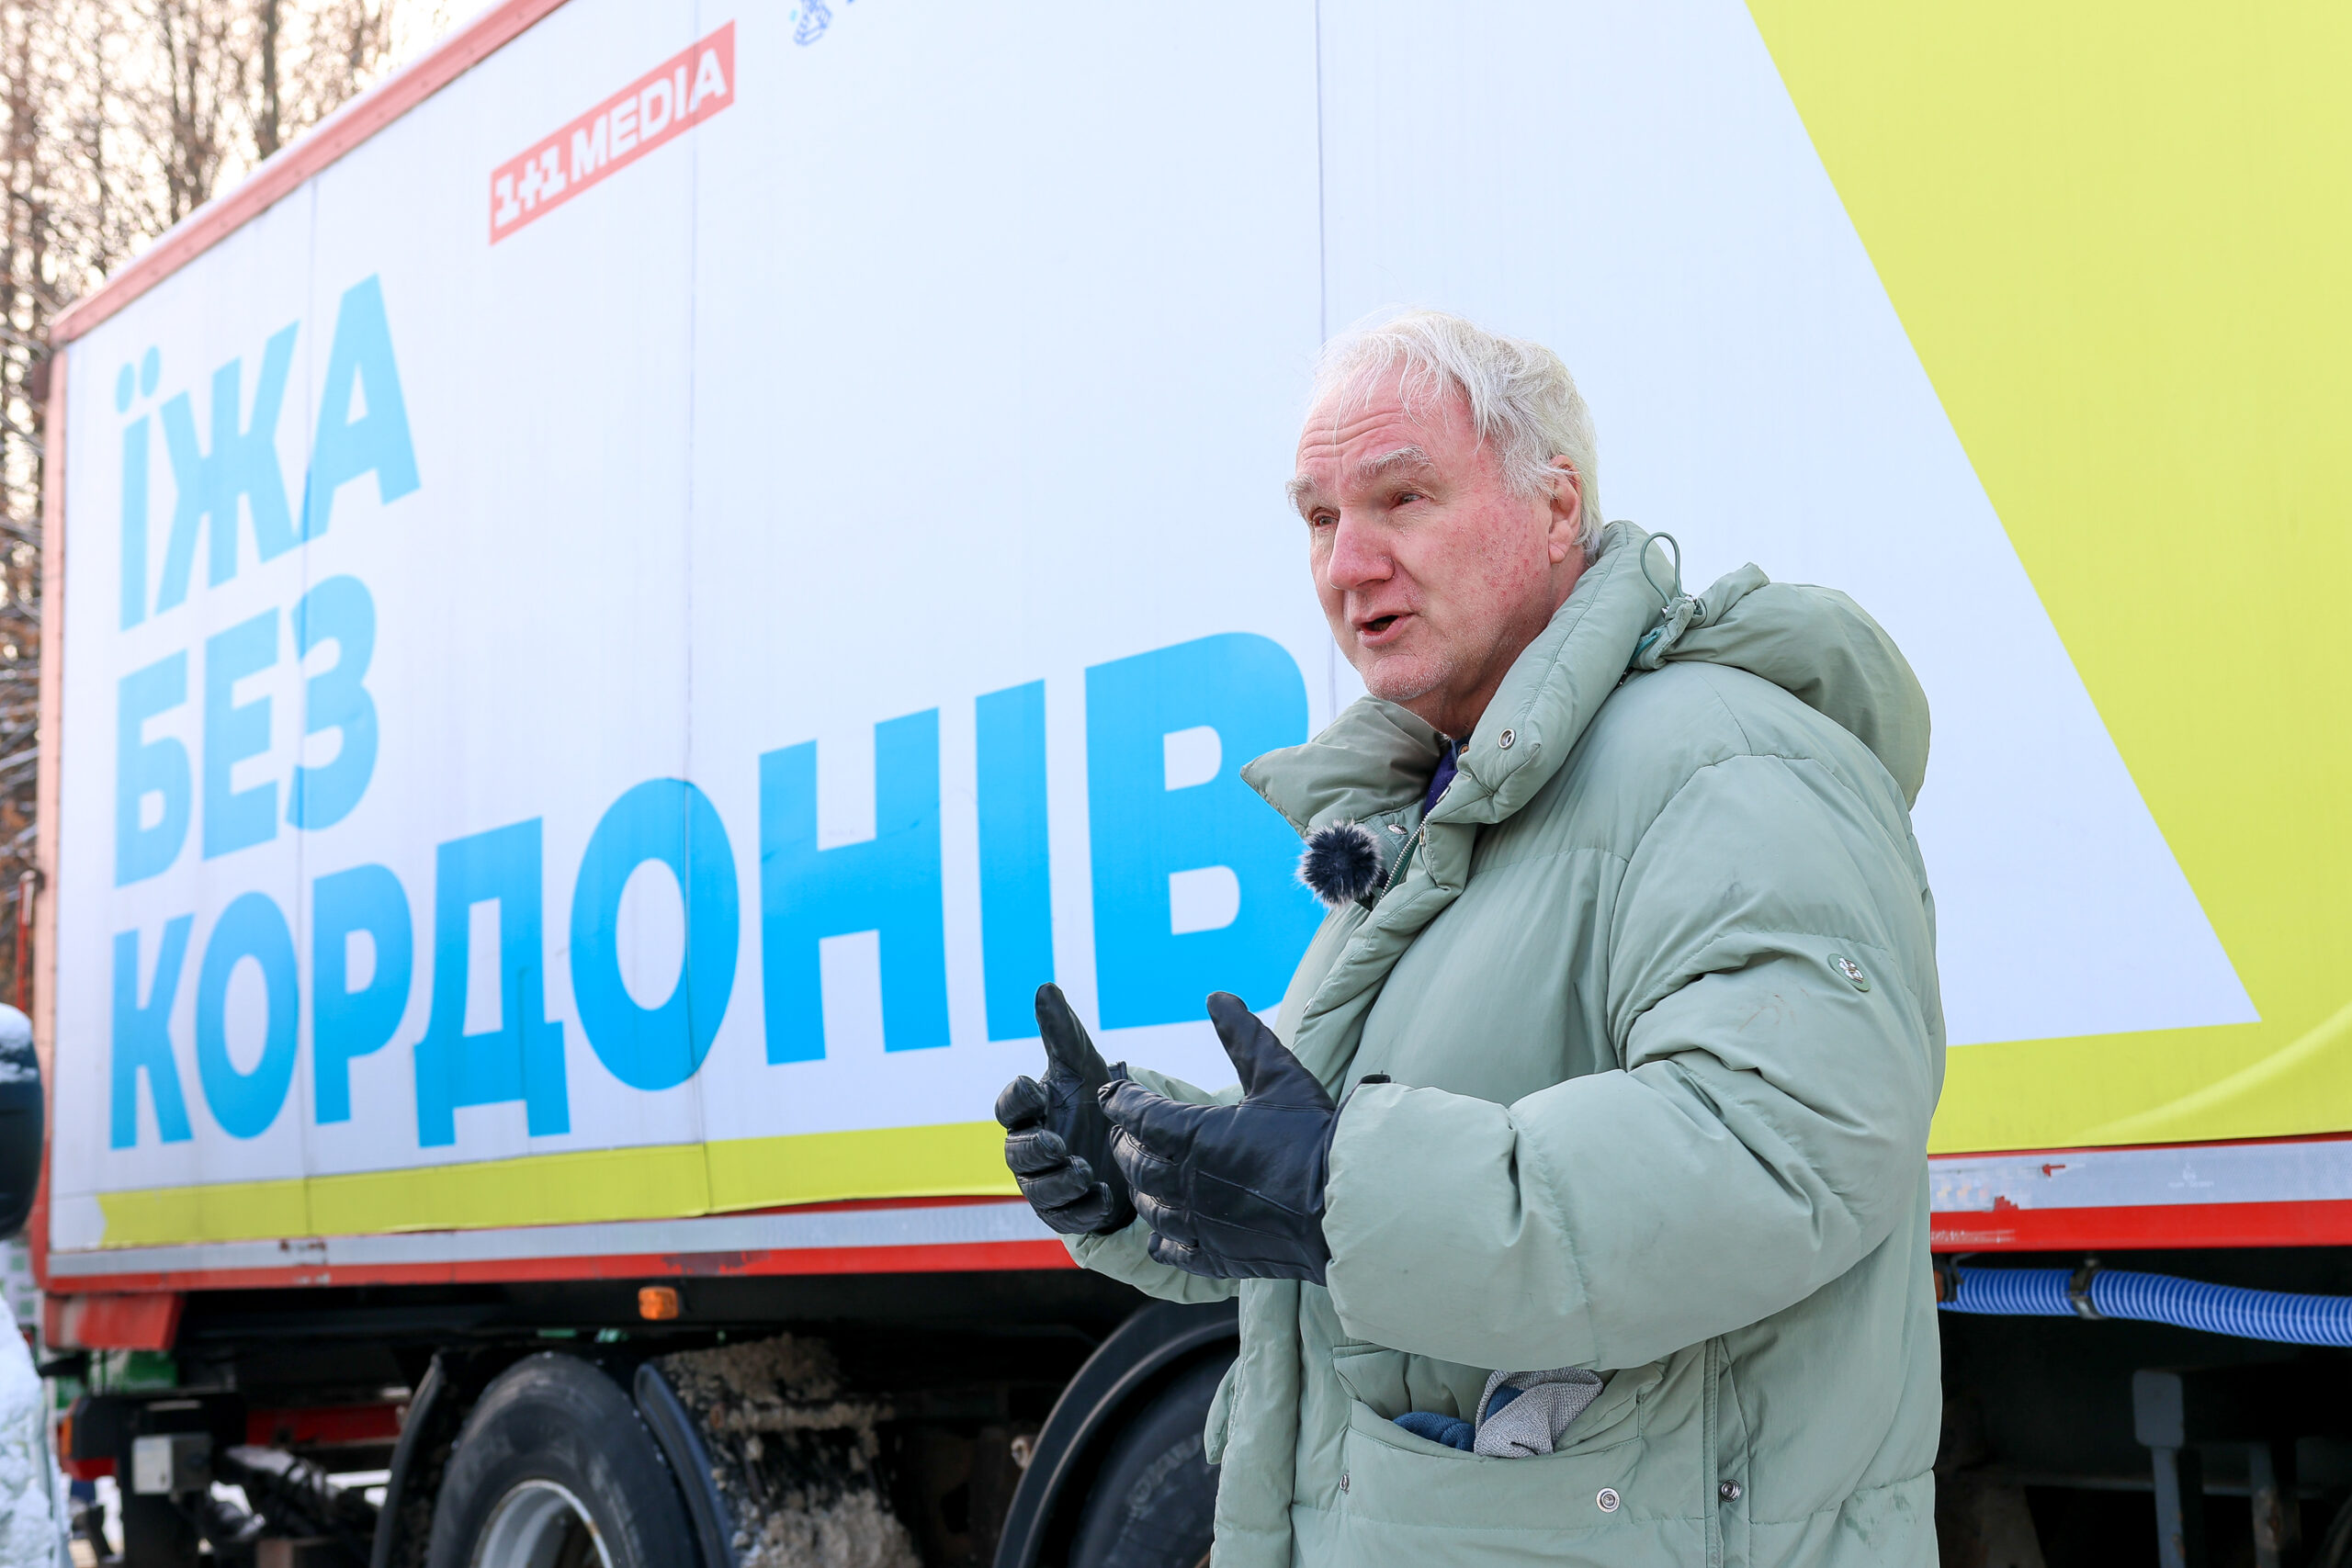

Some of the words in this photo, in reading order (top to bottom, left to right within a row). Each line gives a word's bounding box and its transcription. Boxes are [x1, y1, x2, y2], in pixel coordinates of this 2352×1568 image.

[494, 144, 567, 229] 1+1
[571, 47, 728, 184] MEDIA
[115, 272, 422, 633] ЇЖА
[109, 631, 1324, 1151] КОРДОНІВ
[114, 574, 379, 889] БЕЗ
